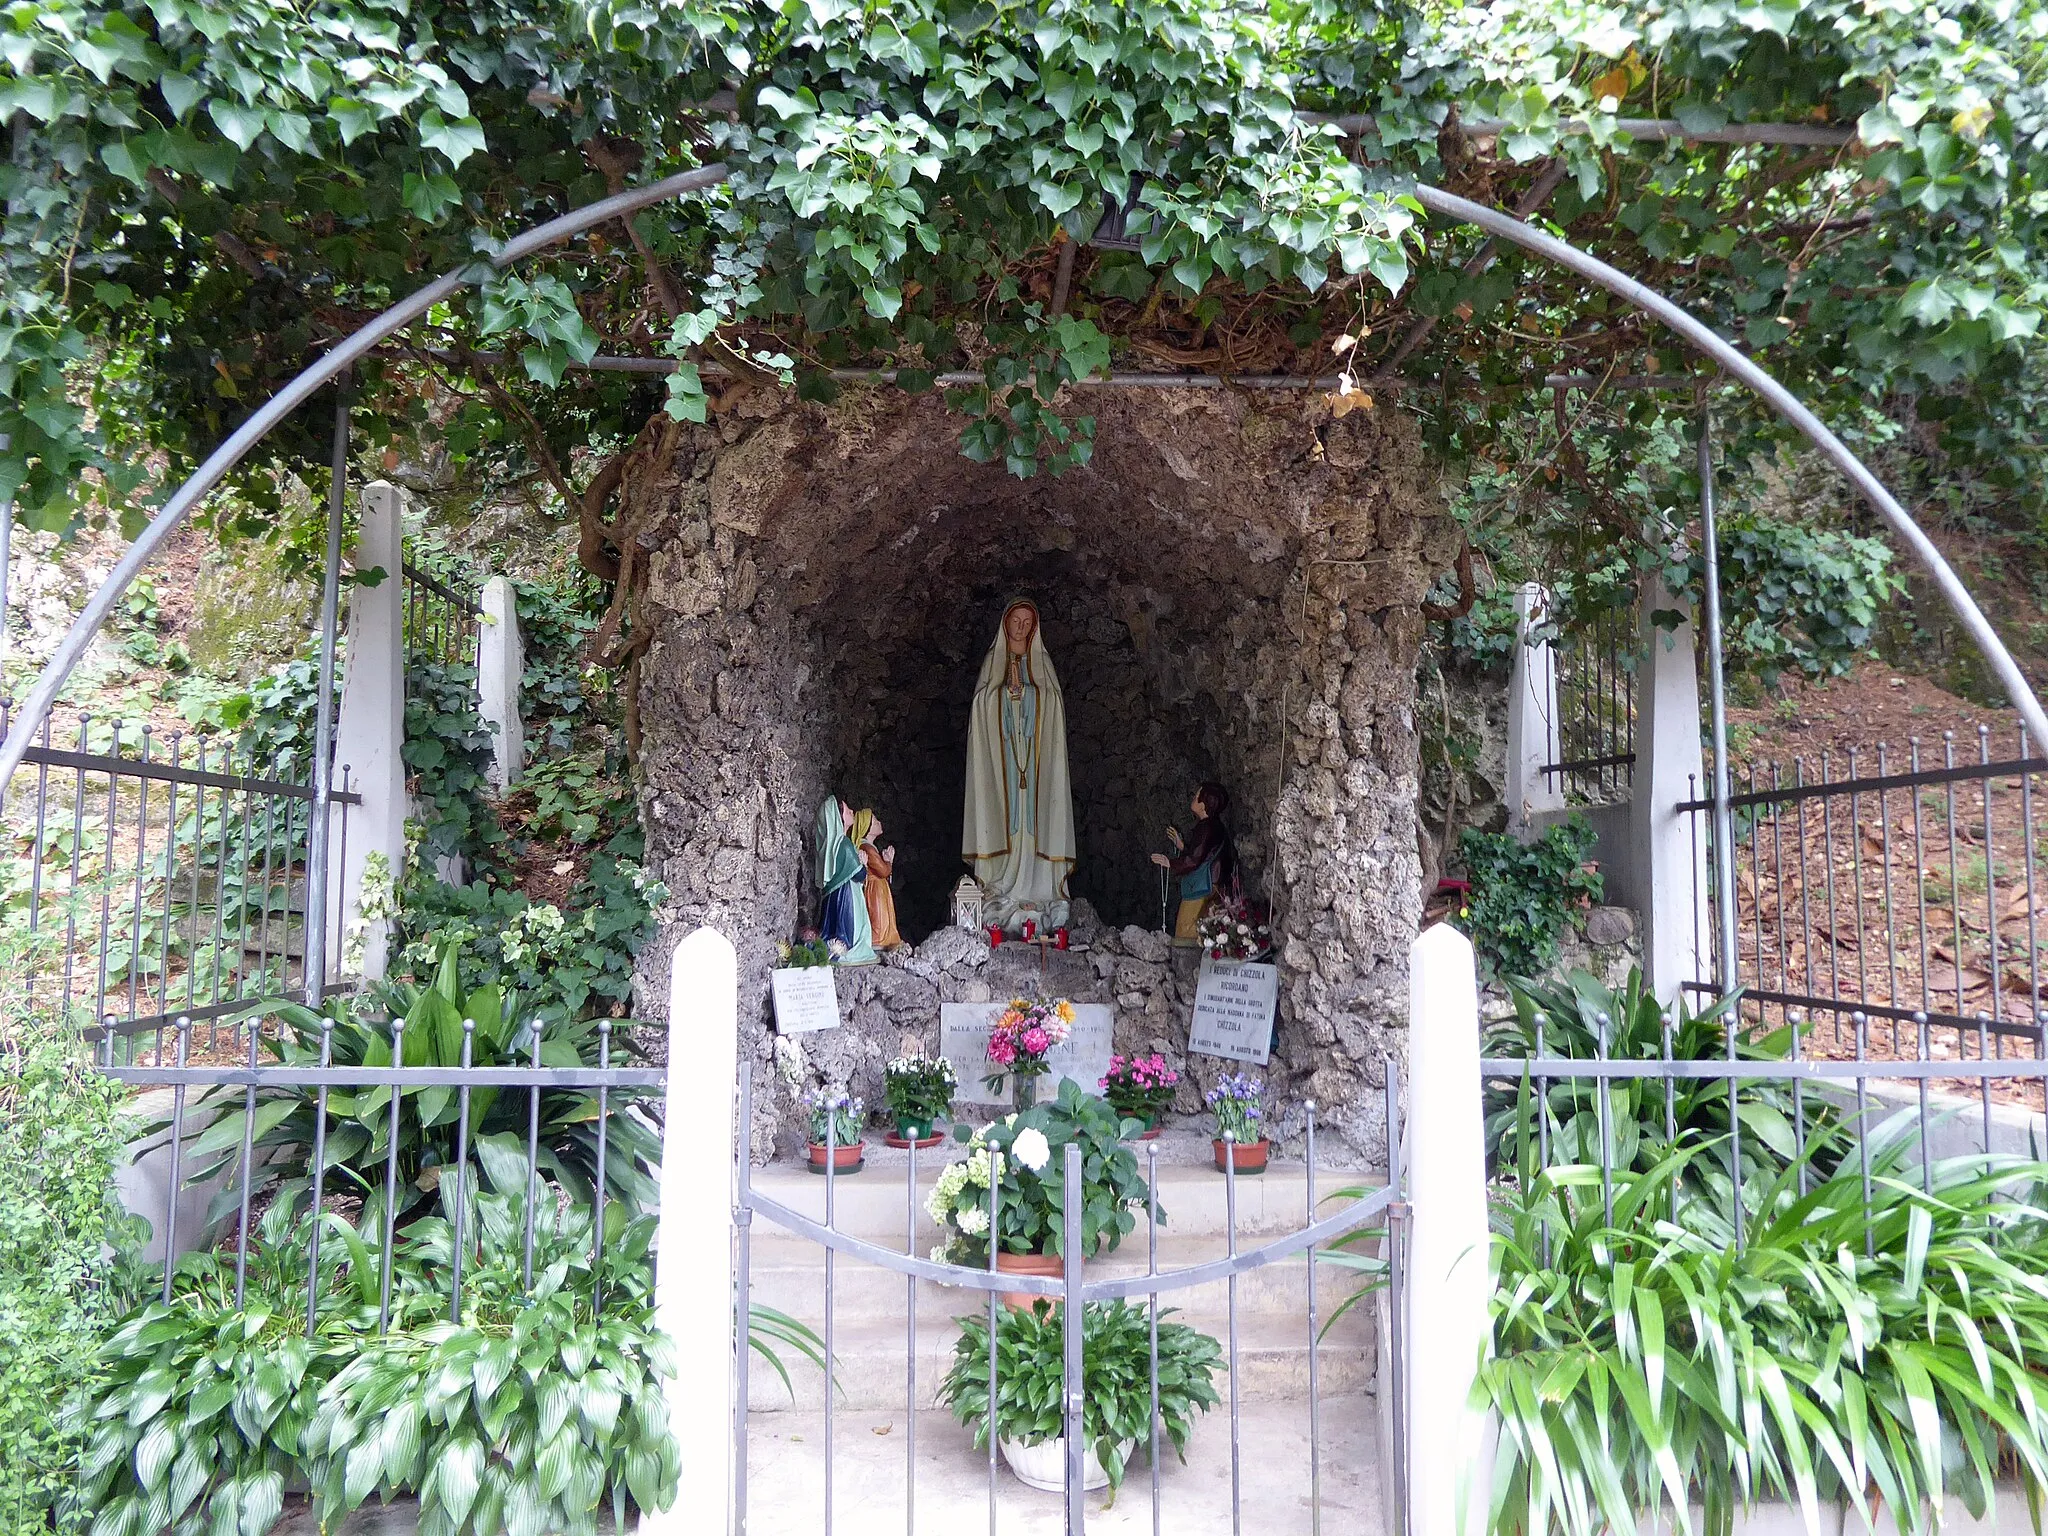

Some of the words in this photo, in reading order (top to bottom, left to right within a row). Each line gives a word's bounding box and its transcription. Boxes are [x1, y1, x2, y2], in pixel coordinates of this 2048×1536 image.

[1213, 966, 1231, 976] REDUCI
[1232, 968, 1238, 978] DI
[1240, 969, 1265, 980] CHIZZOLA
[1220, 981, 1249, 993] RICORDANO
[950, 1025, 970, 1033] DALLA
[1217, 1020, 1242, 1032] CHIZZOLA
